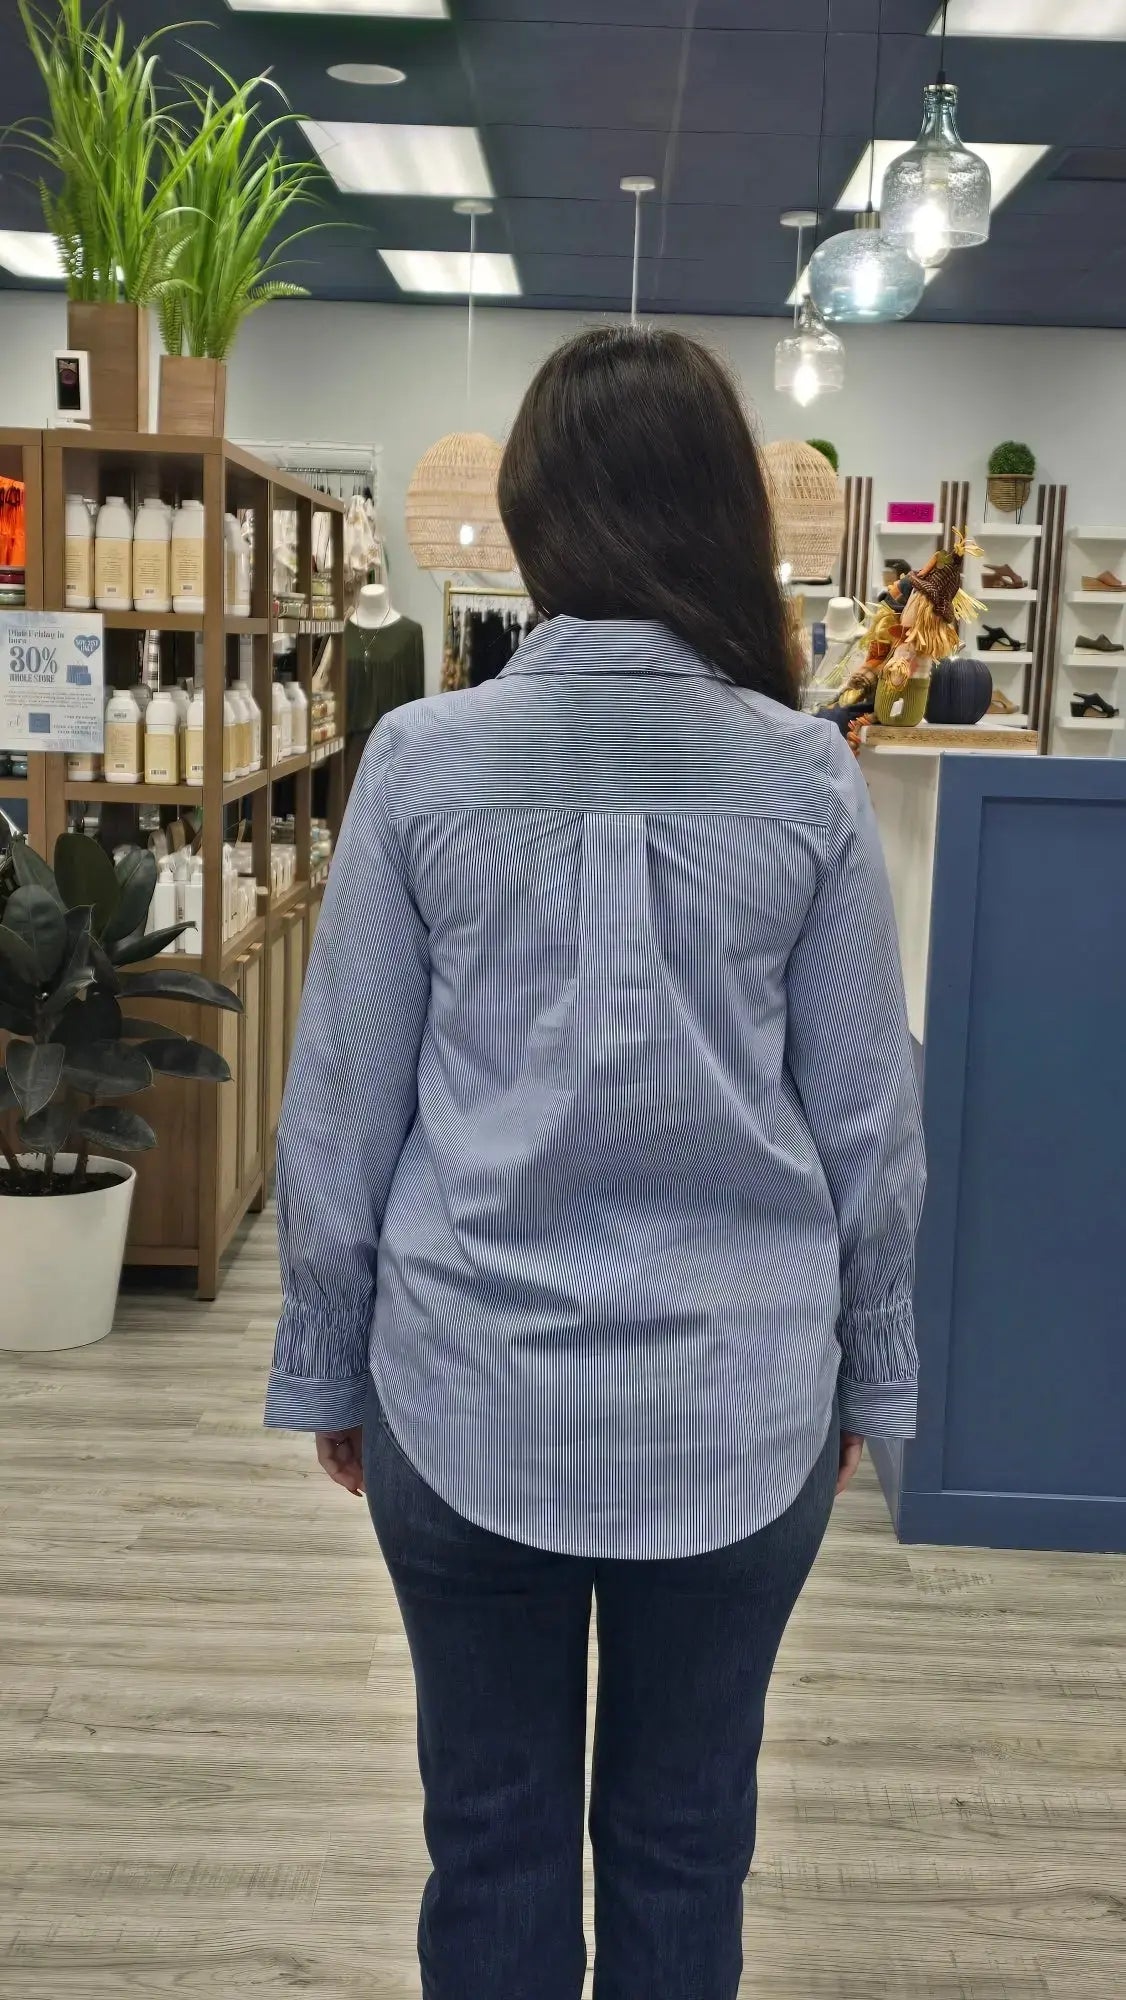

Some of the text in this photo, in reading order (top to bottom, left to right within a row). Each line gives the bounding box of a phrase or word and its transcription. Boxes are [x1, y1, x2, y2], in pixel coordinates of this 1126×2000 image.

[9, 645, 58, 674] 30%
[9, 673, 56, 683] WHOLE STORE
